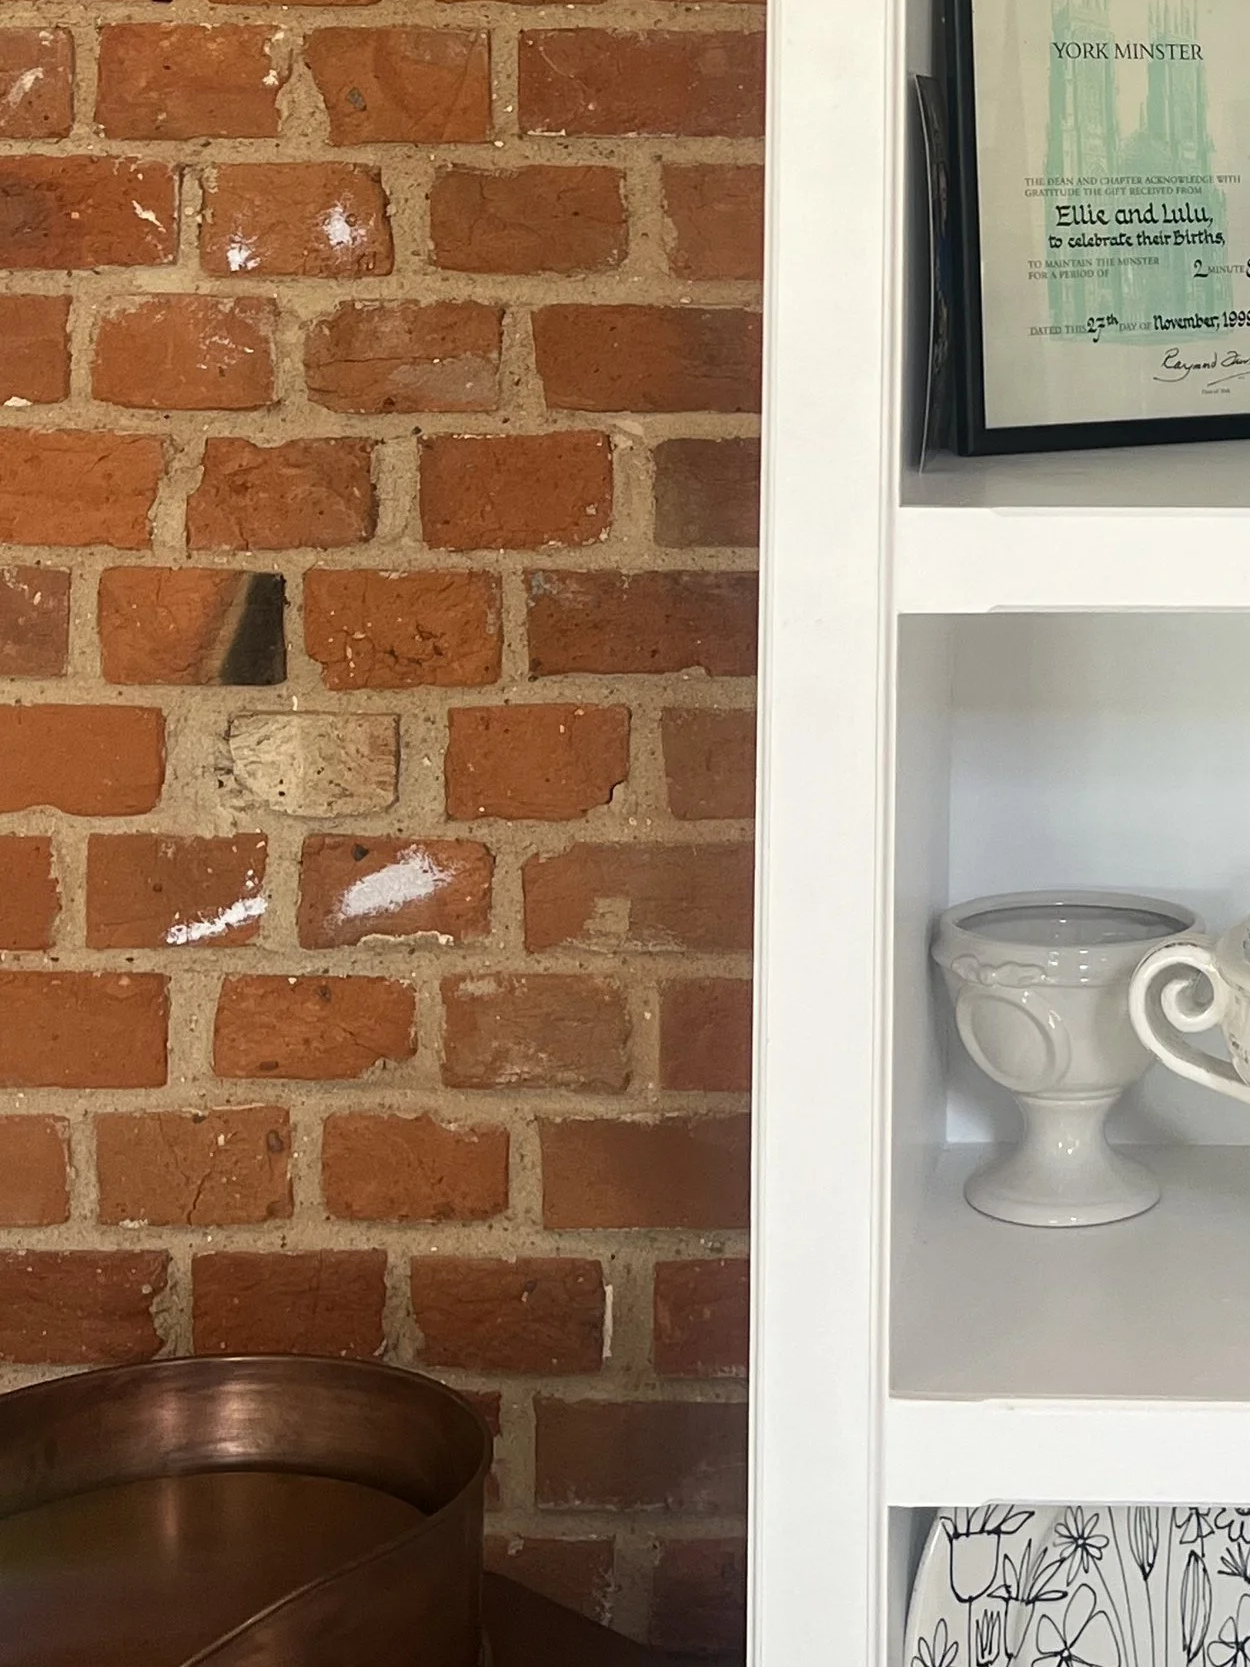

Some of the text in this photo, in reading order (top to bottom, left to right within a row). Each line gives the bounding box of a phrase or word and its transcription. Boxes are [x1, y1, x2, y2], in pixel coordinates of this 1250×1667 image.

[1052, 41, 1204, 61] YORK MINSTER
[1025, 174, 1241, 187] THE DEAN AND CHAPTER ACKNOWLEDGE WITH
[1025, 186, 1202, 198] GRATITUDE THE GIFT RECEIVED FROM
[1055, 202, 1214, 227] Ellie and Lulu,
[1048, 229, 1226, 249] to celebrate their Births,
[1028, 256, 1160, 269] TO MAINTAIN THE MINSTER
[1193, 258, 1208, 278] 2
[1028, 268, 1109, 280] FOR A PERIOD OF
[1030, 325, 1062, 335] DATED
[1064, 324, 1087, 334] THIS
[1119, 322, 1136, 332] DAY
[1138, 321, 1151, 331] OF
[1153, 313, 1220, 332] November,
